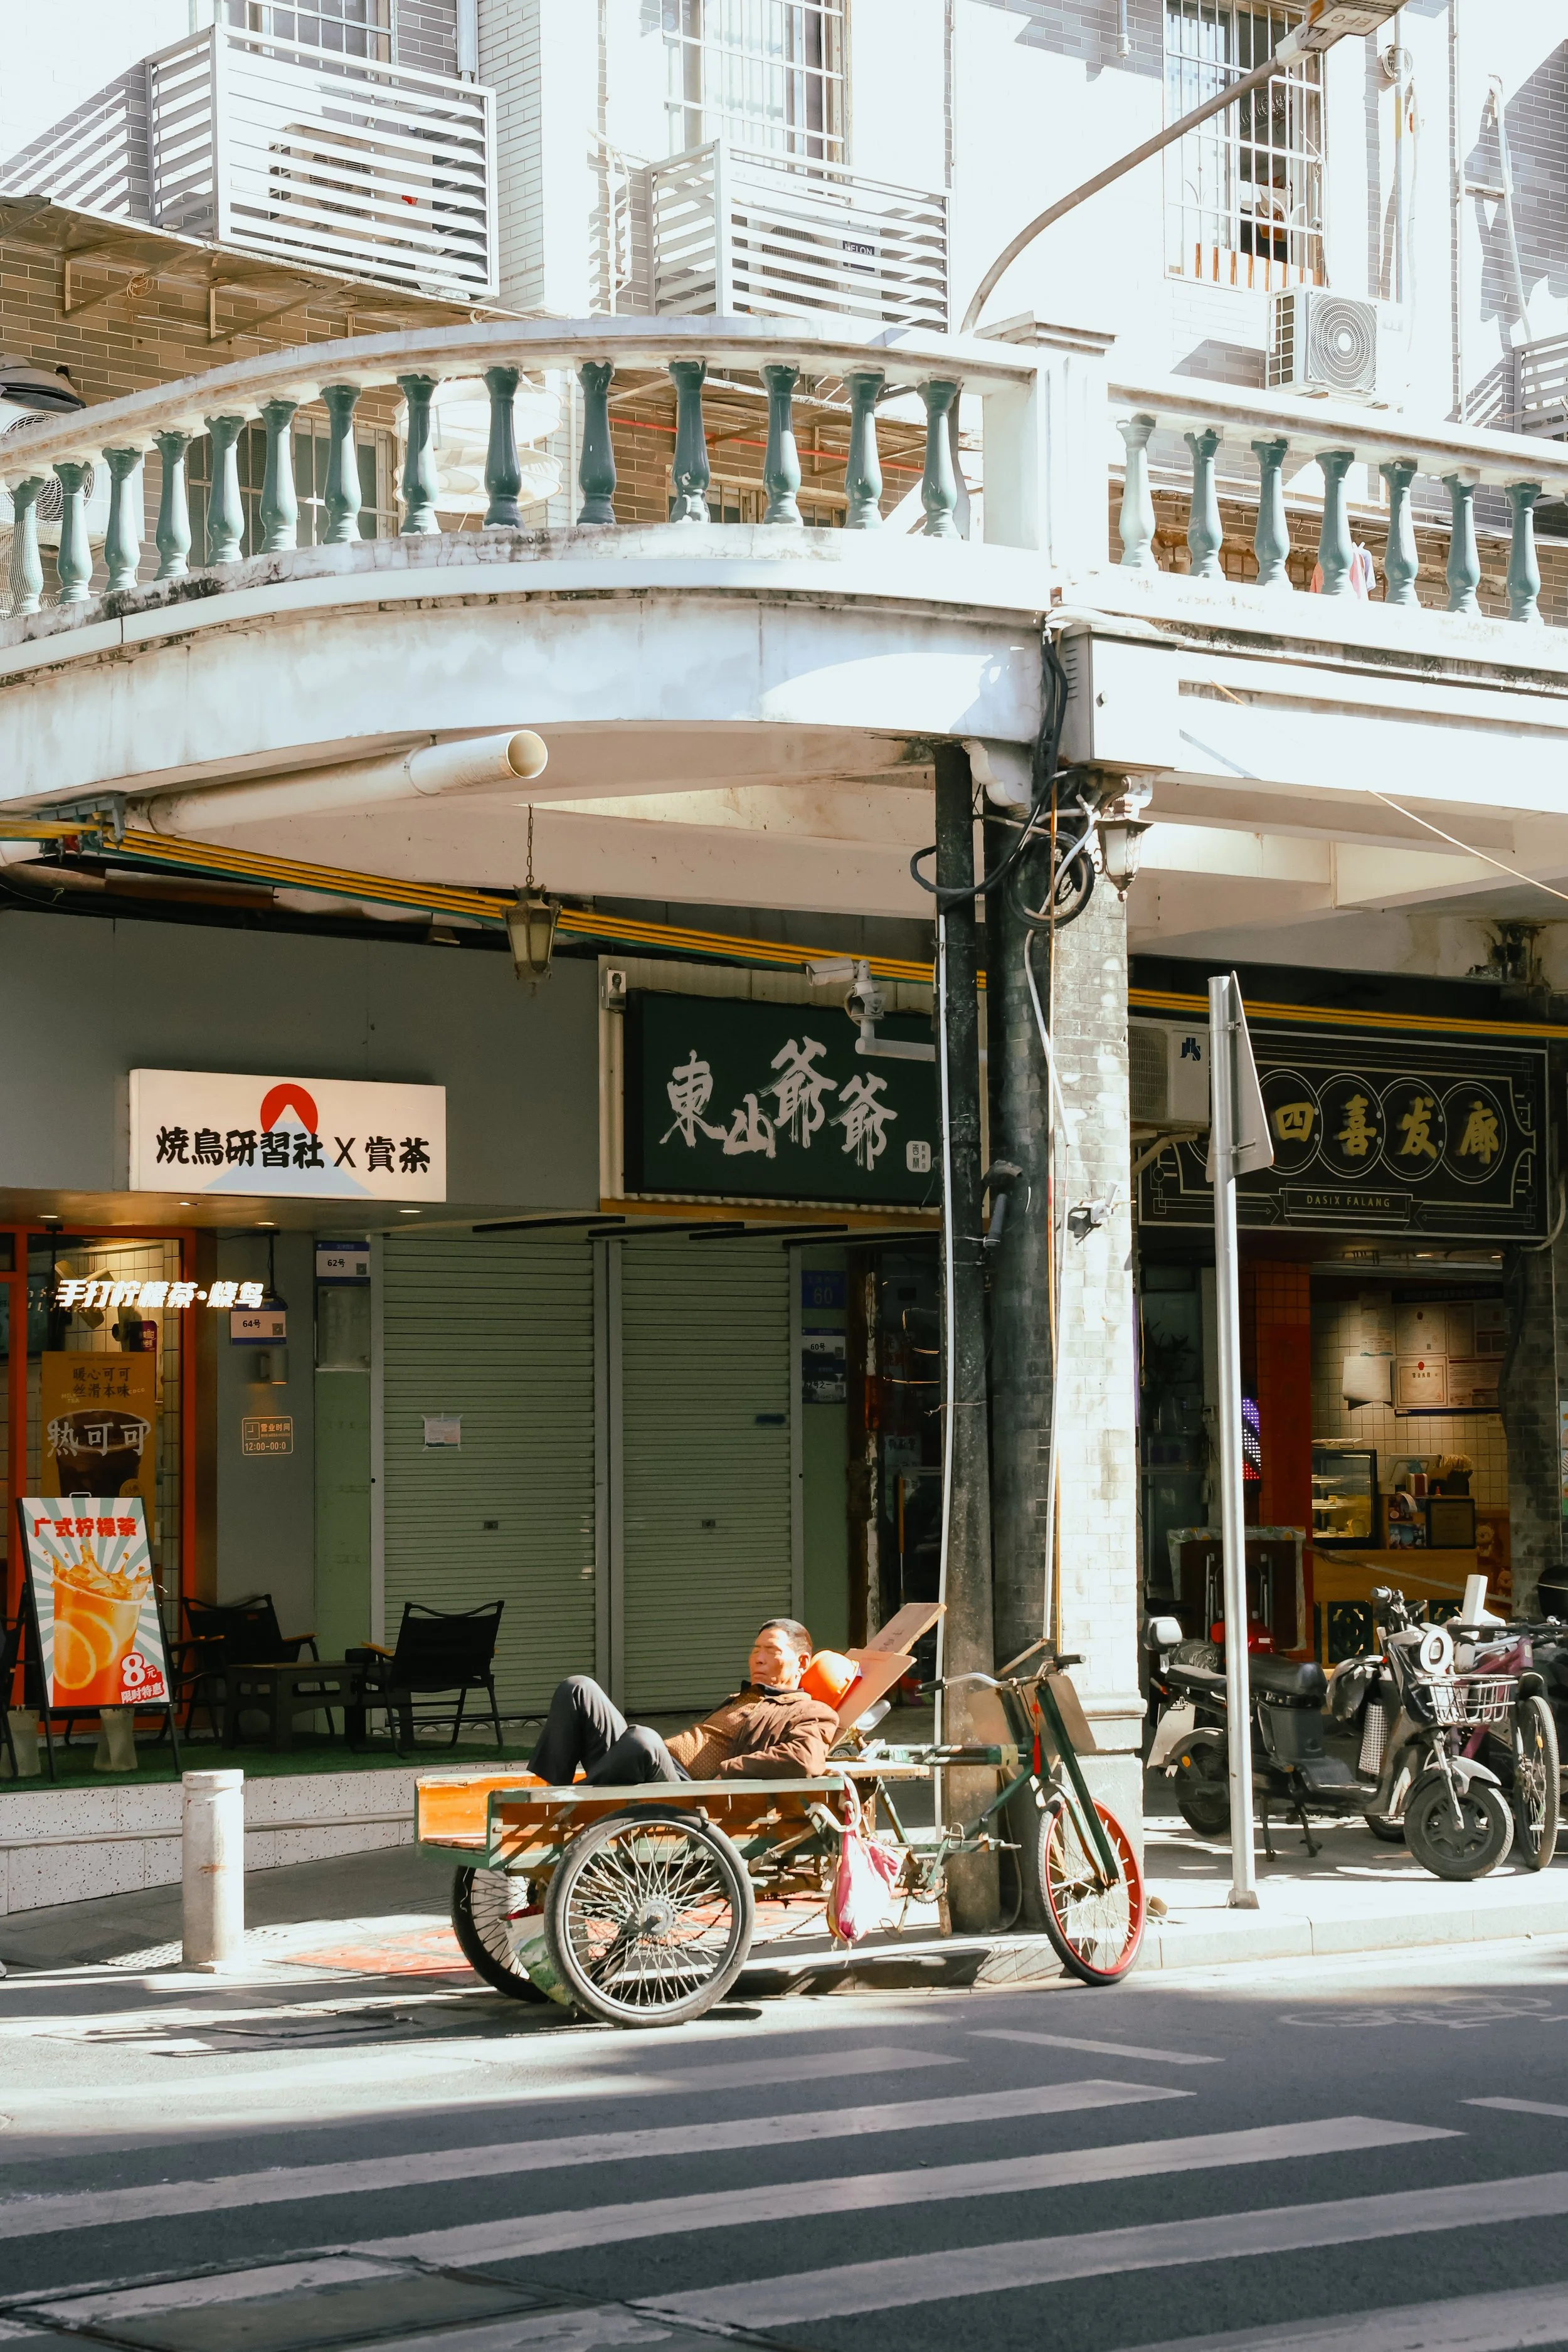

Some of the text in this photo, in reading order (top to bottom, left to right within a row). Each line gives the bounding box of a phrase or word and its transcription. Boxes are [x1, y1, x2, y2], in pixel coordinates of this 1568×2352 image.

[659, 1035, 898, 1171] 東山爺爺
[1274, 1093, 1499, 1165] 四喜发廊
[156, 1126, 324, 1169] 焼鳥研習社
[364, 1136, 430, 1173] 賞茶
[1347, 1197, 1390, 1207] FALANG
[327, 1258, 345, 1268] 62号
[813, 1286, 833, 1305] 60
[242, 1319, 261, 1328] 64号
[810, 1342, 826, 1351] 60号
[73, 1366, 130, 1381] 暖心可可
[73, 1383, 130, 1398] 丝滑本味
[260, 1423, 290, 1432] 营业时间
[47, 1420, 147, 1458] 热可可
[34, 1517, 137, 1537] 广式柠檬茶
[120, 1682, 163, 1704] 限时特惠
